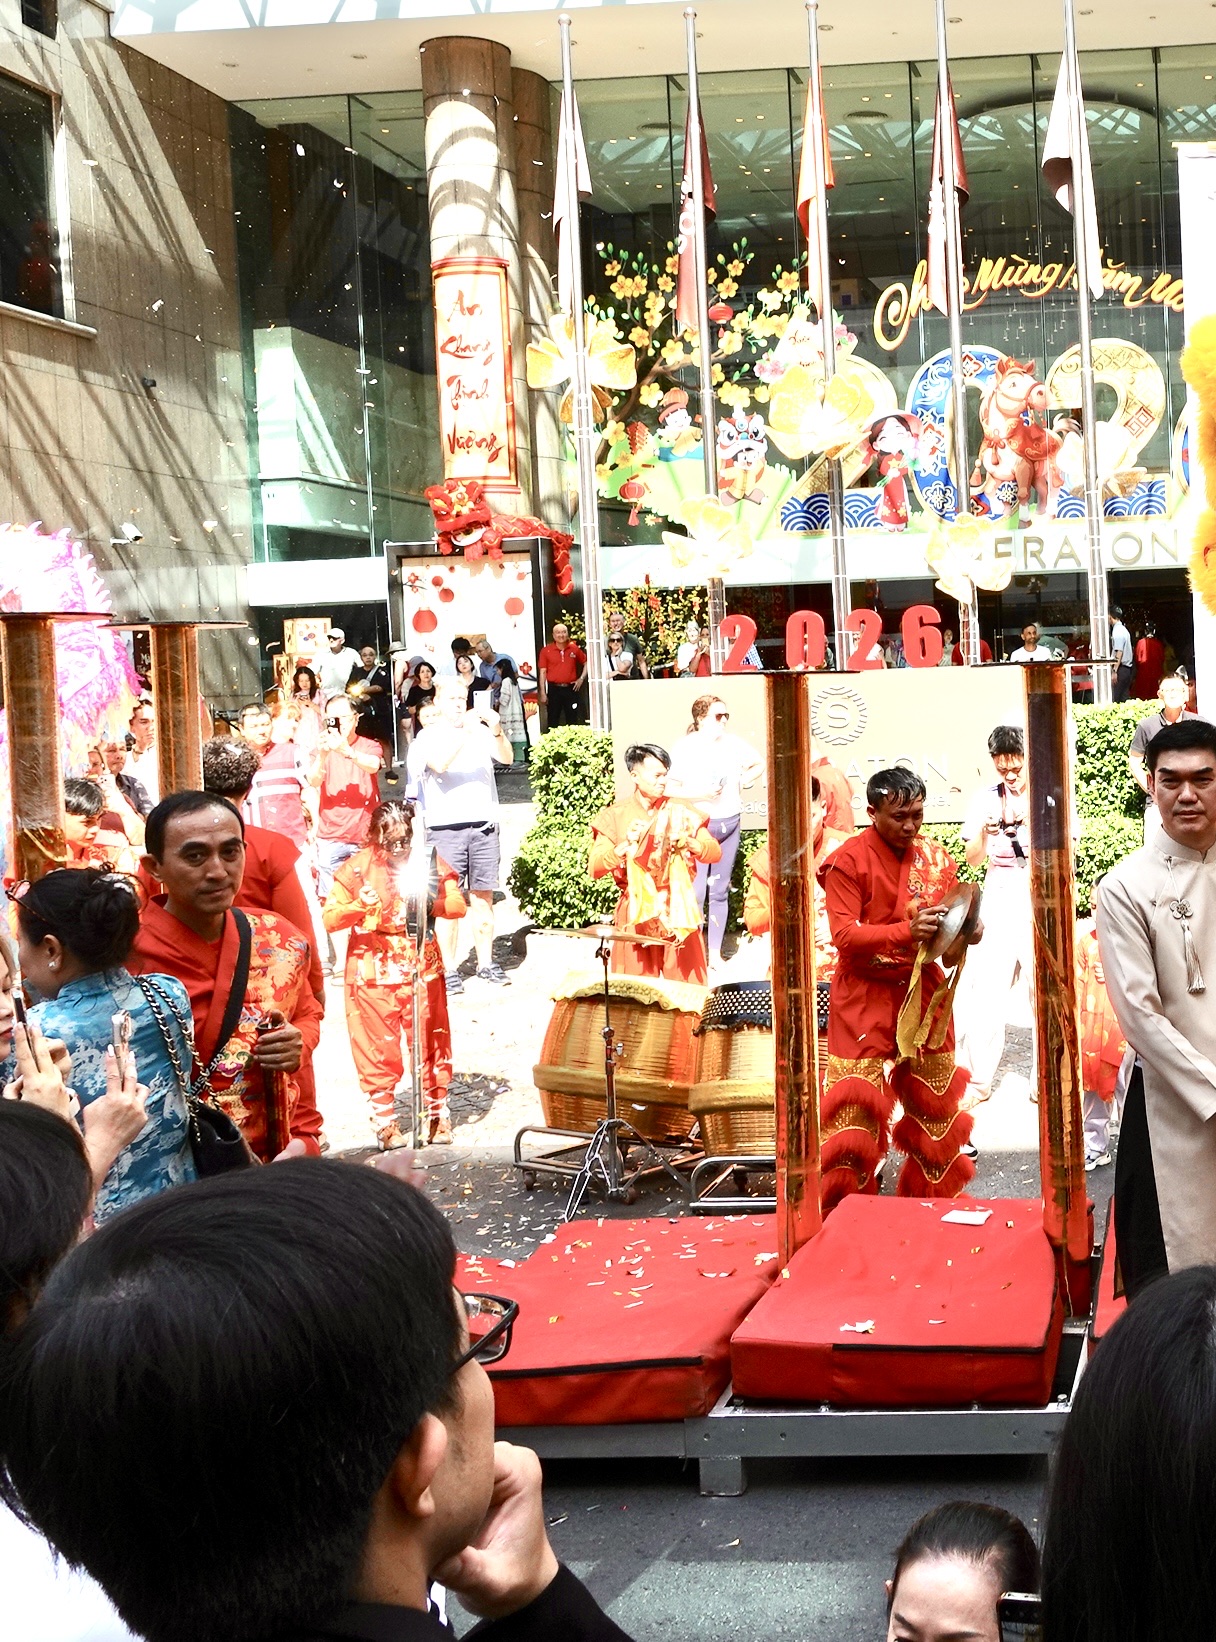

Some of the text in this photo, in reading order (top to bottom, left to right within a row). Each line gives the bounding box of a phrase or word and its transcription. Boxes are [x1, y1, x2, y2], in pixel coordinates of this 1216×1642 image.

[971, 254, 1063, 298] Mừng
[447, 290, 482, 322] An
[440, 334, 494, 366] Khang
[719, 604, 944, 672] 2026
